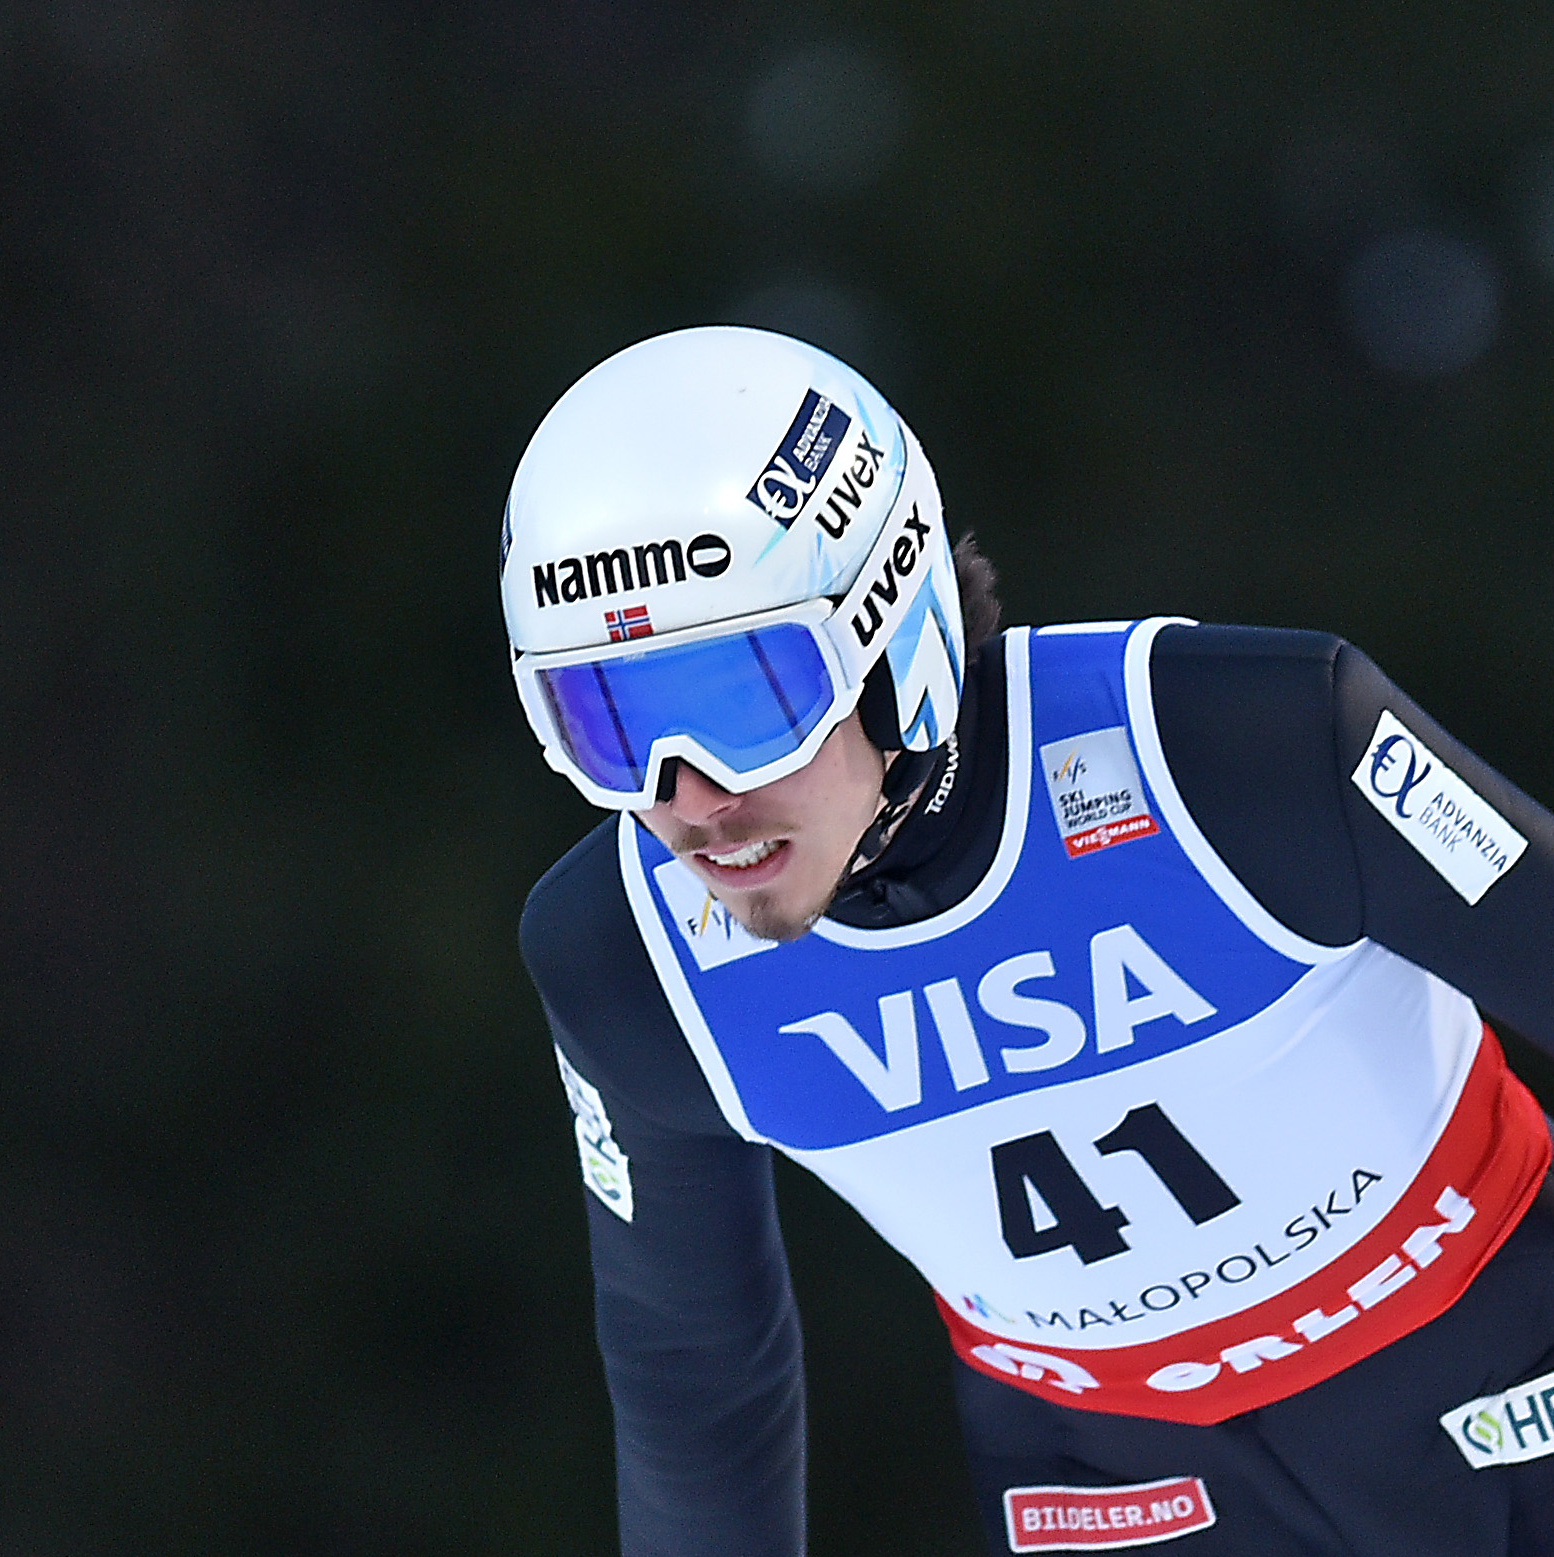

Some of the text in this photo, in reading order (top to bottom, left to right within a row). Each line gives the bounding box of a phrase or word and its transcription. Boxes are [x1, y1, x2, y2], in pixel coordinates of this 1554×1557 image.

[815, 431, 884, 540] uvex
[851, 500, 931, 648] uvex
[1058, 790, 1085, 807] SKI
[1064, 789, 1132, 819] JUMPING
[1066, 801, 1133, 829] WORLD CUP
[1419, 807, 1464, 853] BANK
[1431, 791, 1508, 873] ADVANZIA
[779, 923, 1218, 1113] VISA
[990, 1100, 1243, 1266] 41
[1026, 1167, 1383, 1331] MAŁOPOLSKA
[1146, 1186, 1477, 1391] ORLEN
[1022, 1495, 1194, 1531] BILDELER.NO
